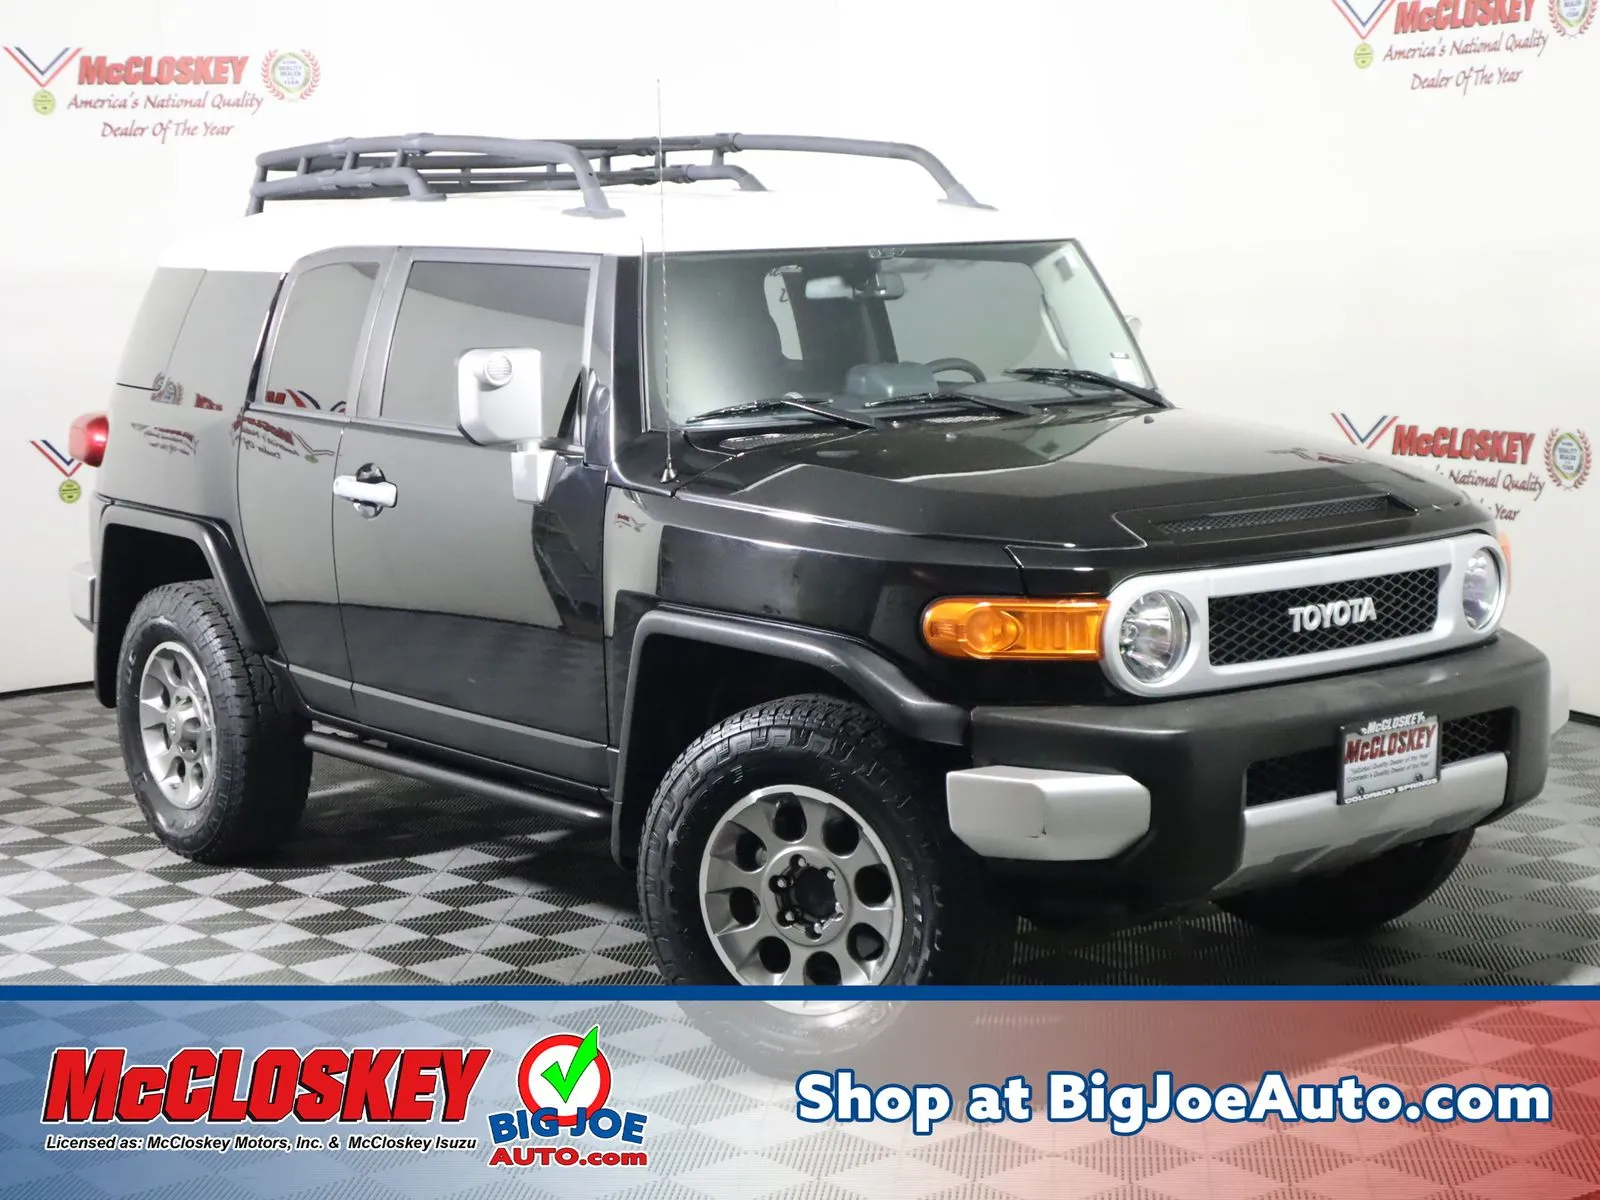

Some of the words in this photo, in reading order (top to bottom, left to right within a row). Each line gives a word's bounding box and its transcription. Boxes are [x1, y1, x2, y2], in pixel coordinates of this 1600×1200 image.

[1394, 0, 1536, 34] McCLOSKEY
[1383, 38, 1446, 62] America's
[1449, 31, 1502, 57] National
[1505, 28, 1549, 58] Quality
[77, 55, 249, 86] McCLOSKEY
[1411, 69, 1453, 90] Dealer
[1455, 65, 1475, 96] Of
[1473, 66, 1494, 86] The
[1496, 67, 1524, 85] Year
[67, 91, 139, 111] America's
[144, 91, 206, 109] National
[211, 92, 263, 115] Quality
[101, 120, 148, 138] Dealer
[152, 120, 173, 144] Of
[173, 121, 199, 137] The
[203, 121, 234, 137] Year
[1391, 424, 1536, 465] McCLOSKEY
[1448, 469, 1502, 490] National
[1503, 472, 1545, 501] Quality
[1495, 502, 1521, 521] Year
[1288, 596, 1377, 632] TOYOTA
[1344, 724, 1436, 764] McCLOSKEY
[1345, 788, 1396, 804] COLORADO
[1397, 778, 1438, 792] SPRINGS
